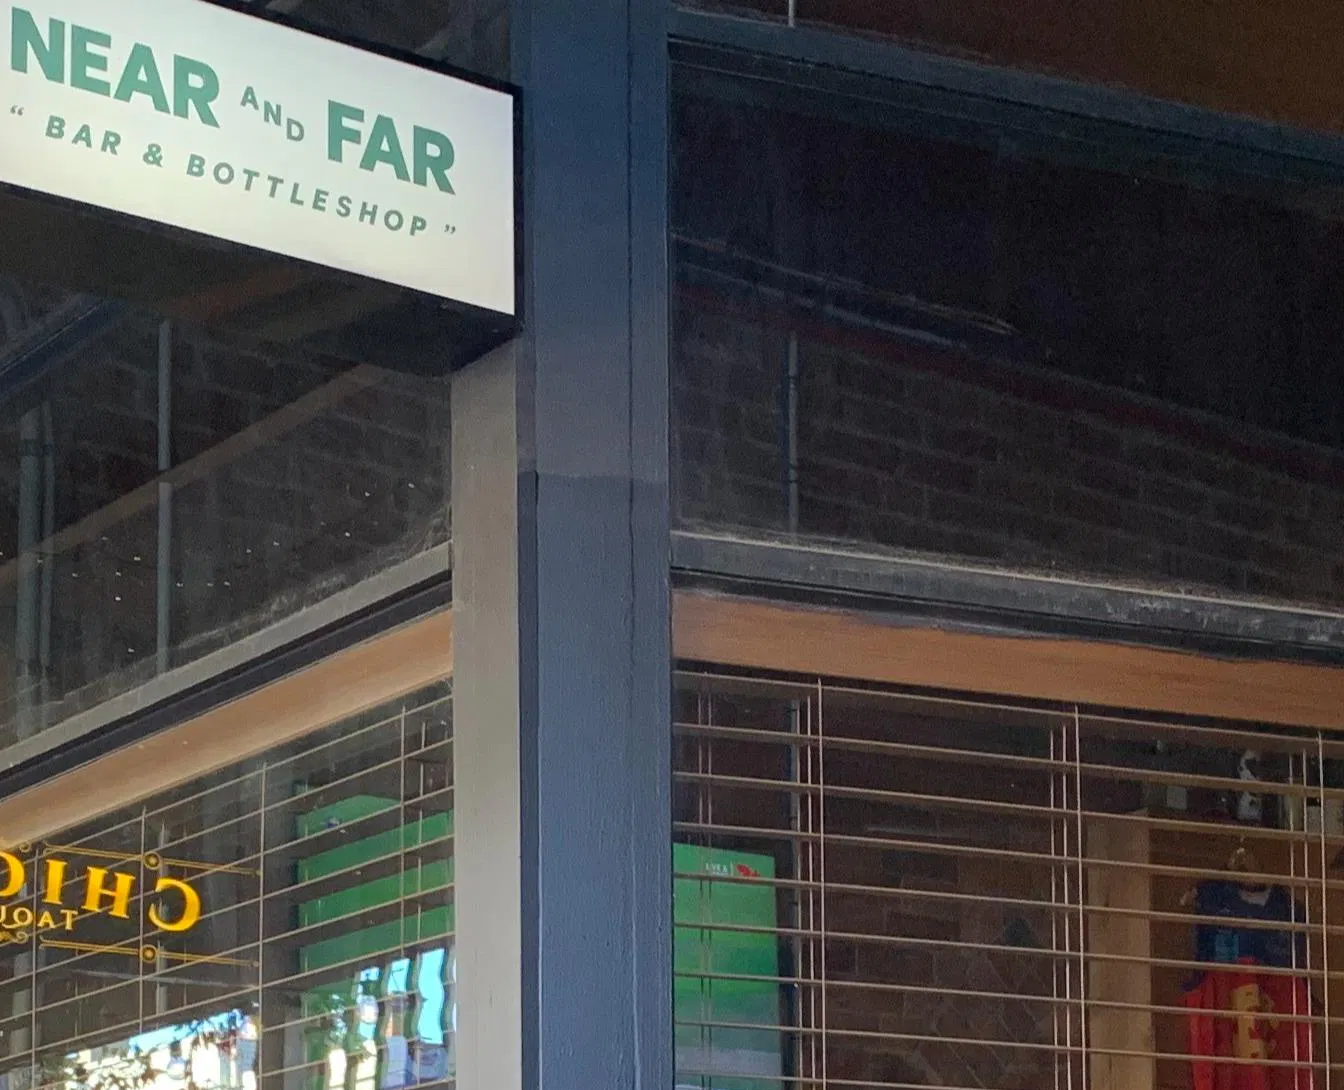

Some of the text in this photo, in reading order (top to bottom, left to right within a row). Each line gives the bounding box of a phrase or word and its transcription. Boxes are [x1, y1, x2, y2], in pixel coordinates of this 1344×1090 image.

[11, 6, 457, 195] NEAR AND FAR
[45, 115, 428, 237] BAR & BOTTLESHOP
